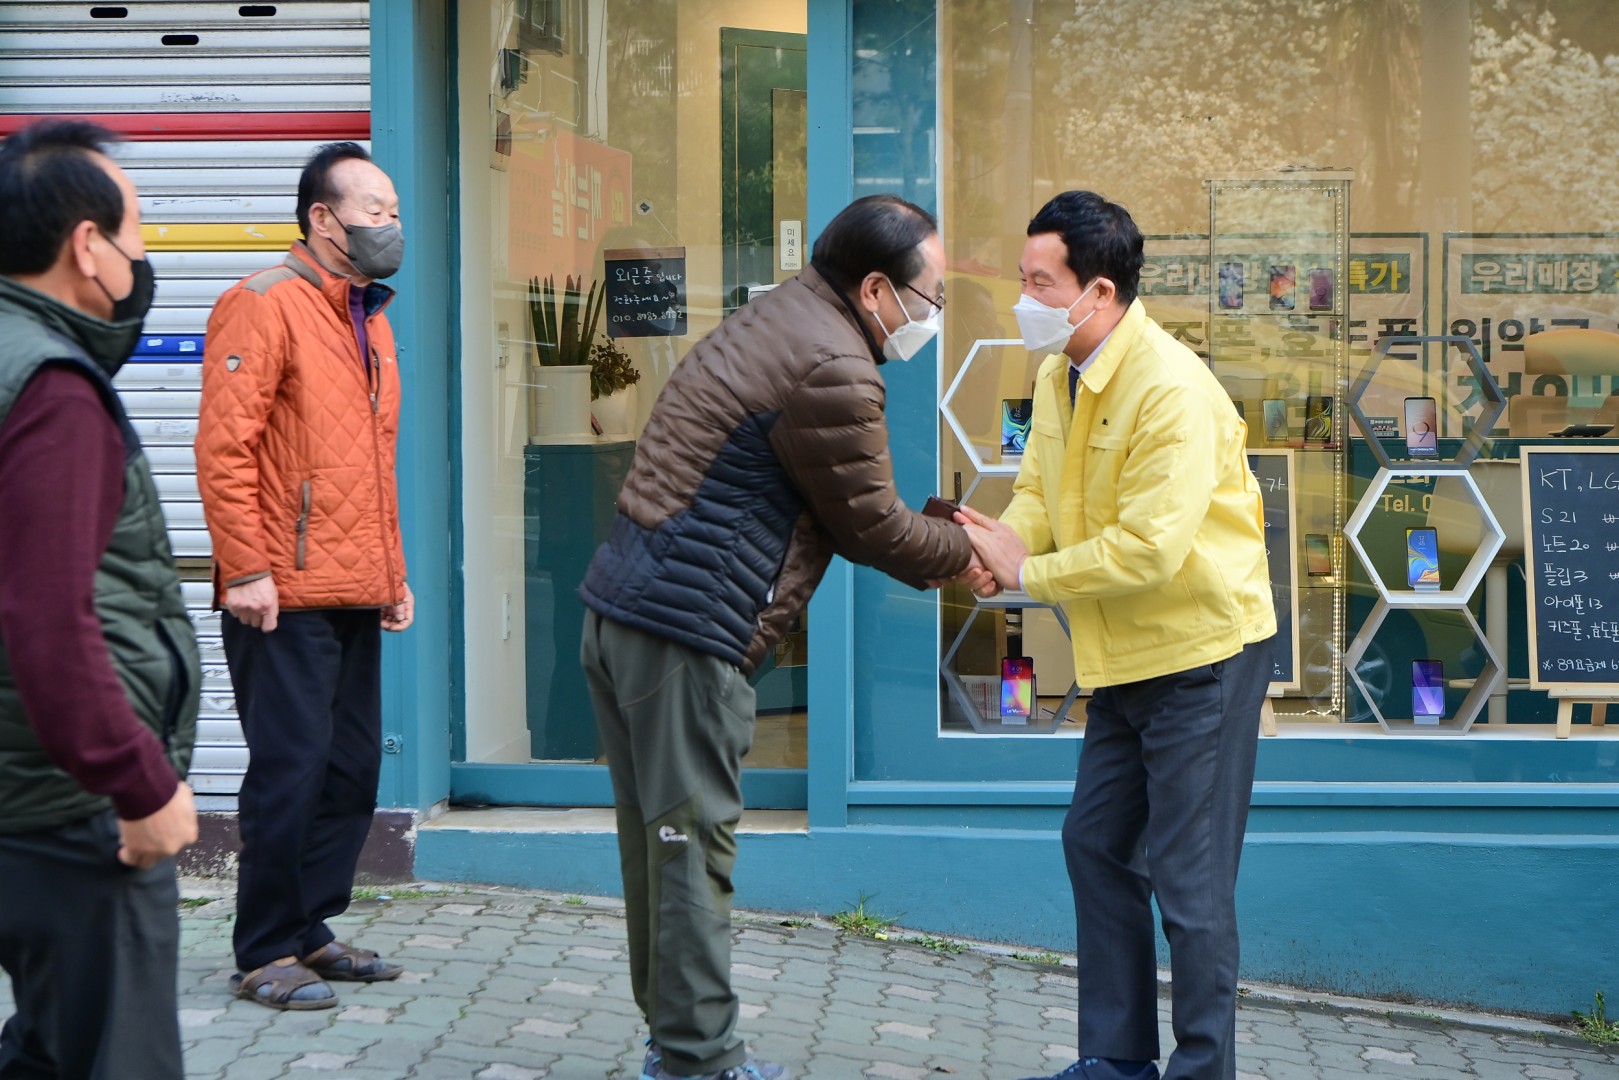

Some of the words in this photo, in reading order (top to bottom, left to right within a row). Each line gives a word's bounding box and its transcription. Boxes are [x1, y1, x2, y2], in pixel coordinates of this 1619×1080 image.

[787, 228, 795, 257] 미세요
[615, 266, 654, 286] 외근중
[656, 272, 683, 283] 입니다
[1471, 261, 1602, 292] 우리매장
[1381, 494, 1416, 513] Tel.
